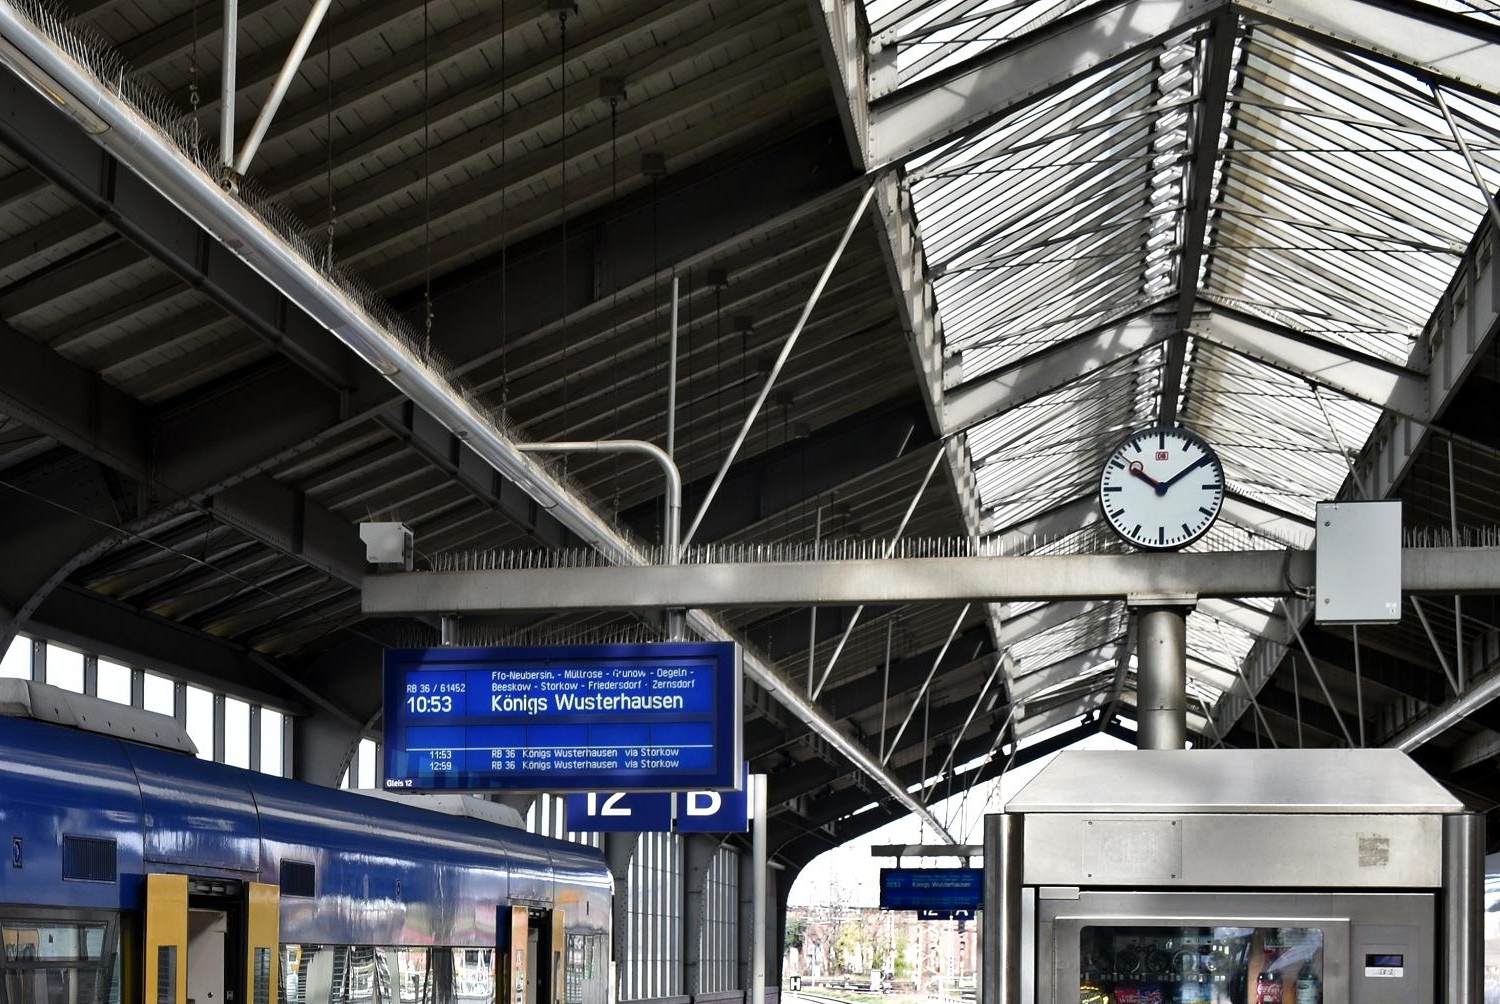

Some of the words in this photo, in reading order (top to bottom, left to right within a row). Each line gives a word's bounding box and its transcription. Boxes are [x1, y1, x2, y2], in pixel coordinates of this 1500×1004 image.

[564, 670, 602, 679] Müllrose
[407, 684, 417, 693] RB
[420, 684, 430, 692] 36
[440, 683, 466, 692] 61452
[492, 682, 531, 691] Beeskow
[541, 681, 578, 690] Storkow
[588, 680, 642, 690] Friedersdorf
[652, 679, 695, 689] Zernsdorf
[407, 695, 452, 713] 10:53
[491, 694, 548, 715] Königs
[555, 693, 684, 710] Wusterhausen
[430, 751, 452, 760] 11:53
[492, 750, 502, 759] RB
[505, 750, 515, 758] 36
[522, 749, 551, 759] Königs
[554, 748, 617, 758] Wusterhausen
[625, 748, 638, 757] via
[641, 747, 679, 757] Storkow
[429, 762, 452, 771] 12:59
[492, 761, 502, 770] RB
[505, 761, 515, 770] 36
[522, 760, 551, 771] Königs
[554, 760, 617, 769] Wusterhausen
[625, 759, 638, 768] via
[641, 758, 679, 768] Storkow
[387, 779, 404, 787] Gleis
[405, 779, 413, 787] 12
